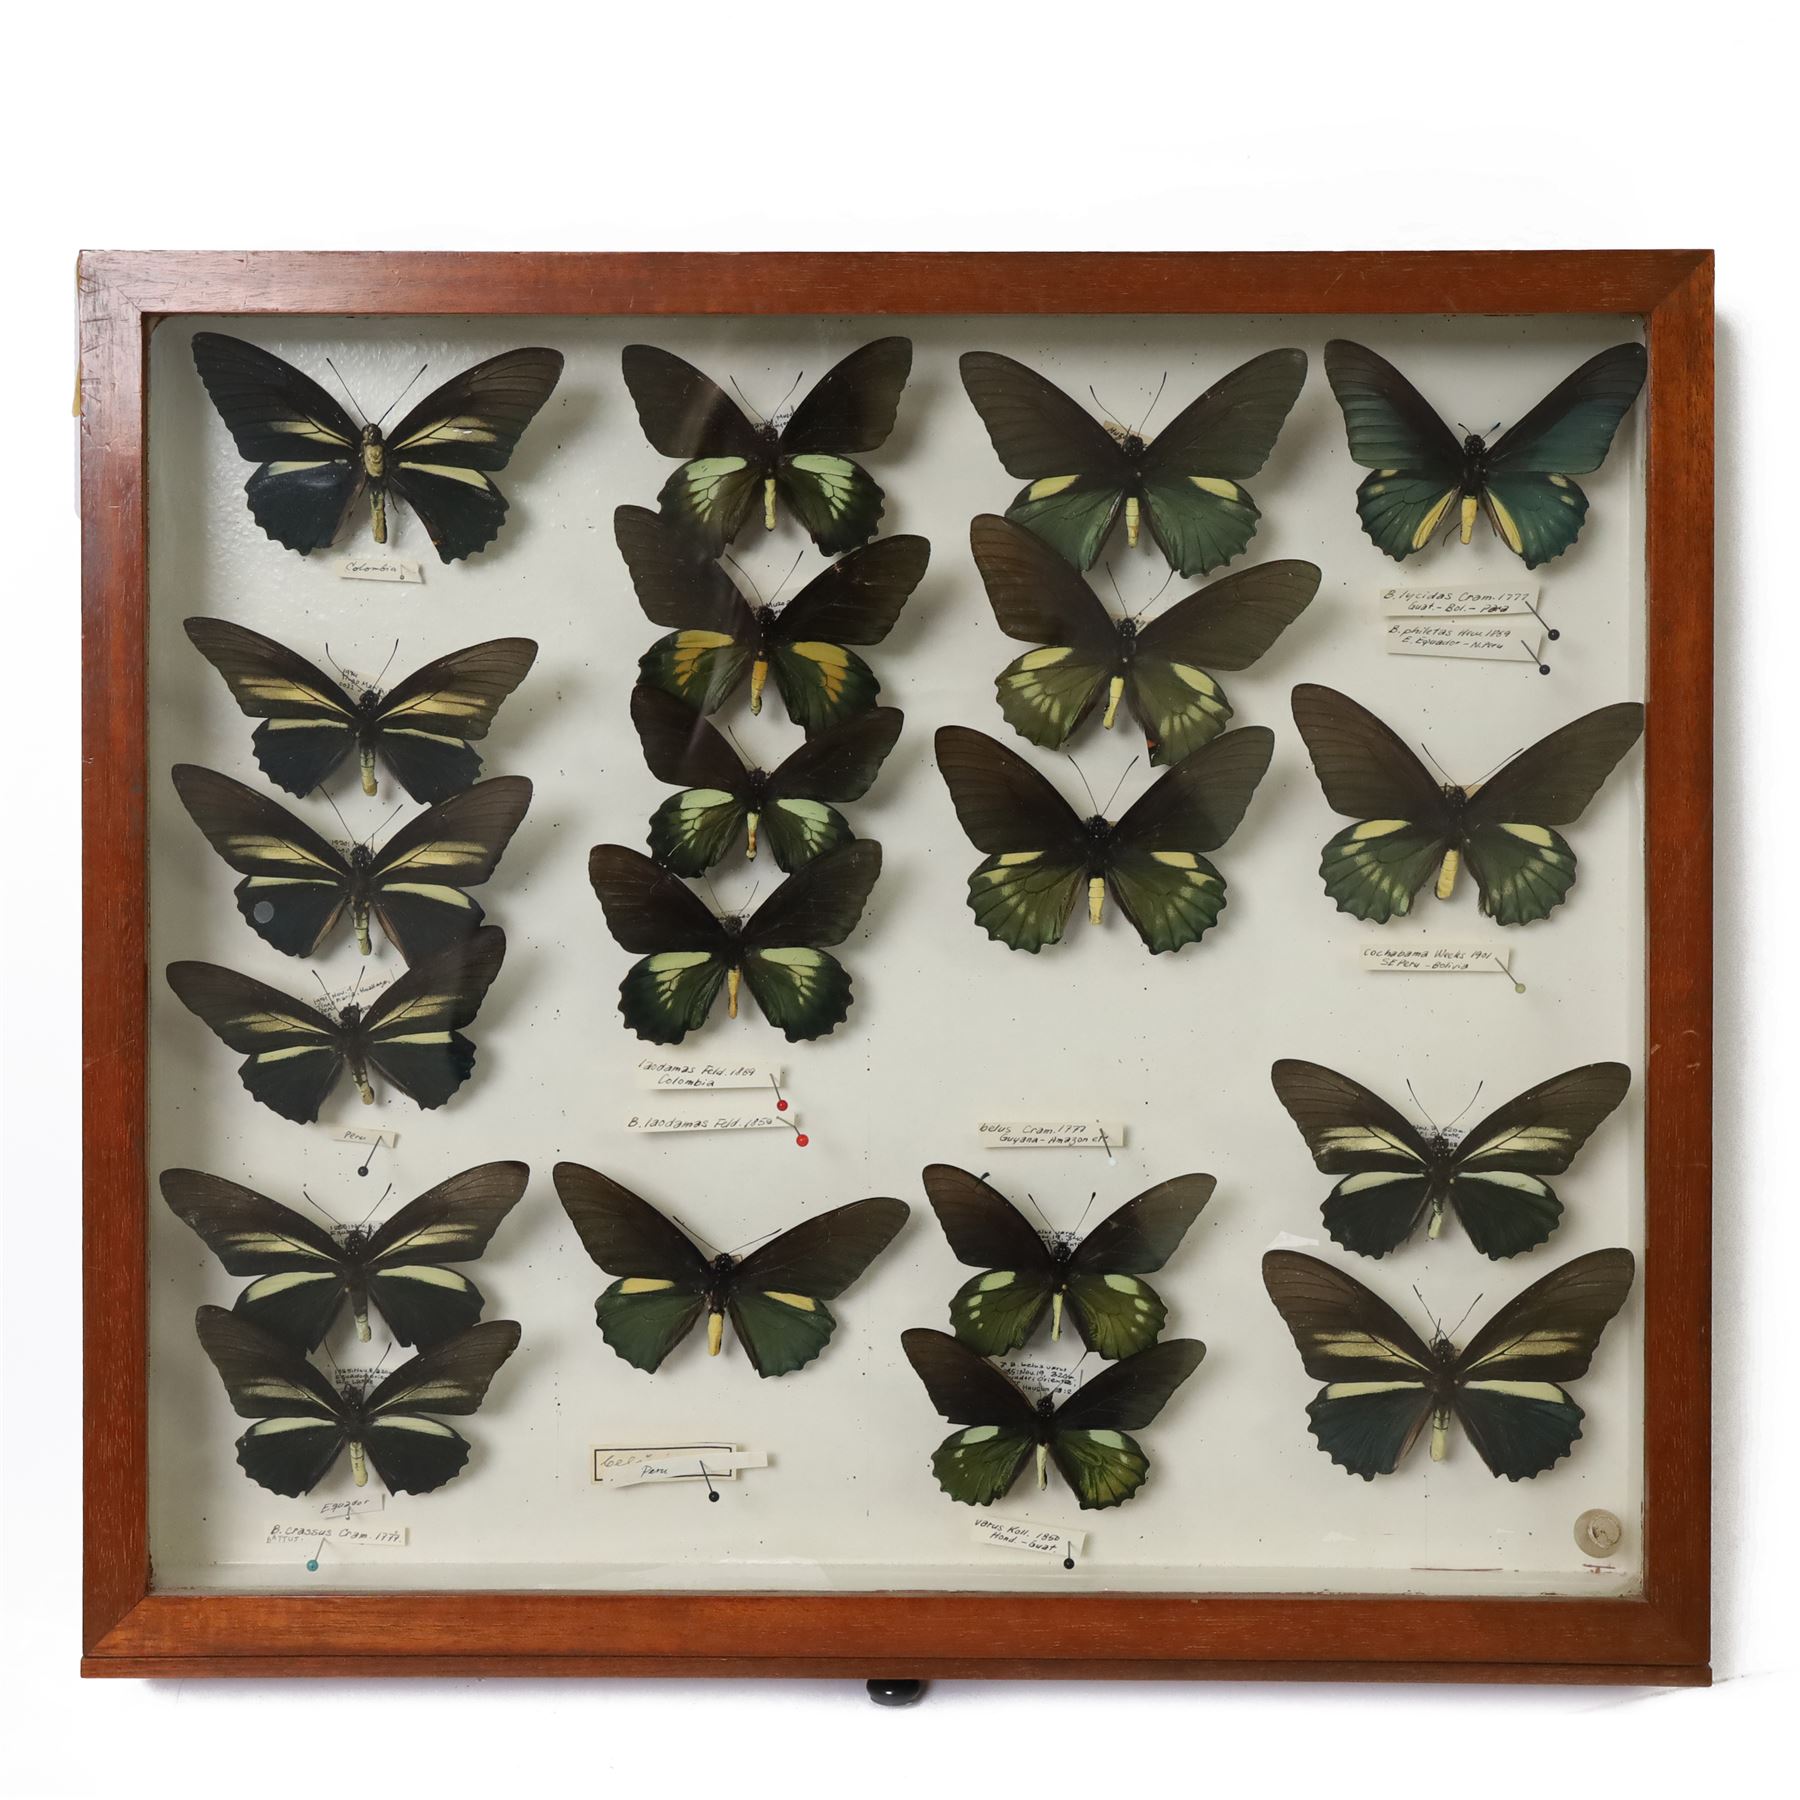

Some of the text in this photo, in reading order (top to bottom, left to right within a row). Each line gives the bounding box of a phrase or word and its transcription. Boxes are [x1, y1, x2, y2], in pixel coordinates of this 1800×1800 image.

[345, 560, 397, 572] Colombia
[1383, 589, 1395, 600] B.
[1399, 590, 1452, 602] lycidas
[1498, 592, 1529, 601] 1777
[1470, 950, 1493, 959] 1901
[658, 1074, 715, 1088] Colombia
[628, 1116, 641, 1128] B.
[645, 1117, 708, 1128] laodamas
[980, 1122, 1011, 1134] belus
[1058, 1124, 1087, 1133] 1777
[344, 1130, 366, 1140] Peru
[271, 1524, 282, 1535] B.
[974, 1519, 1005, 1532] varus
